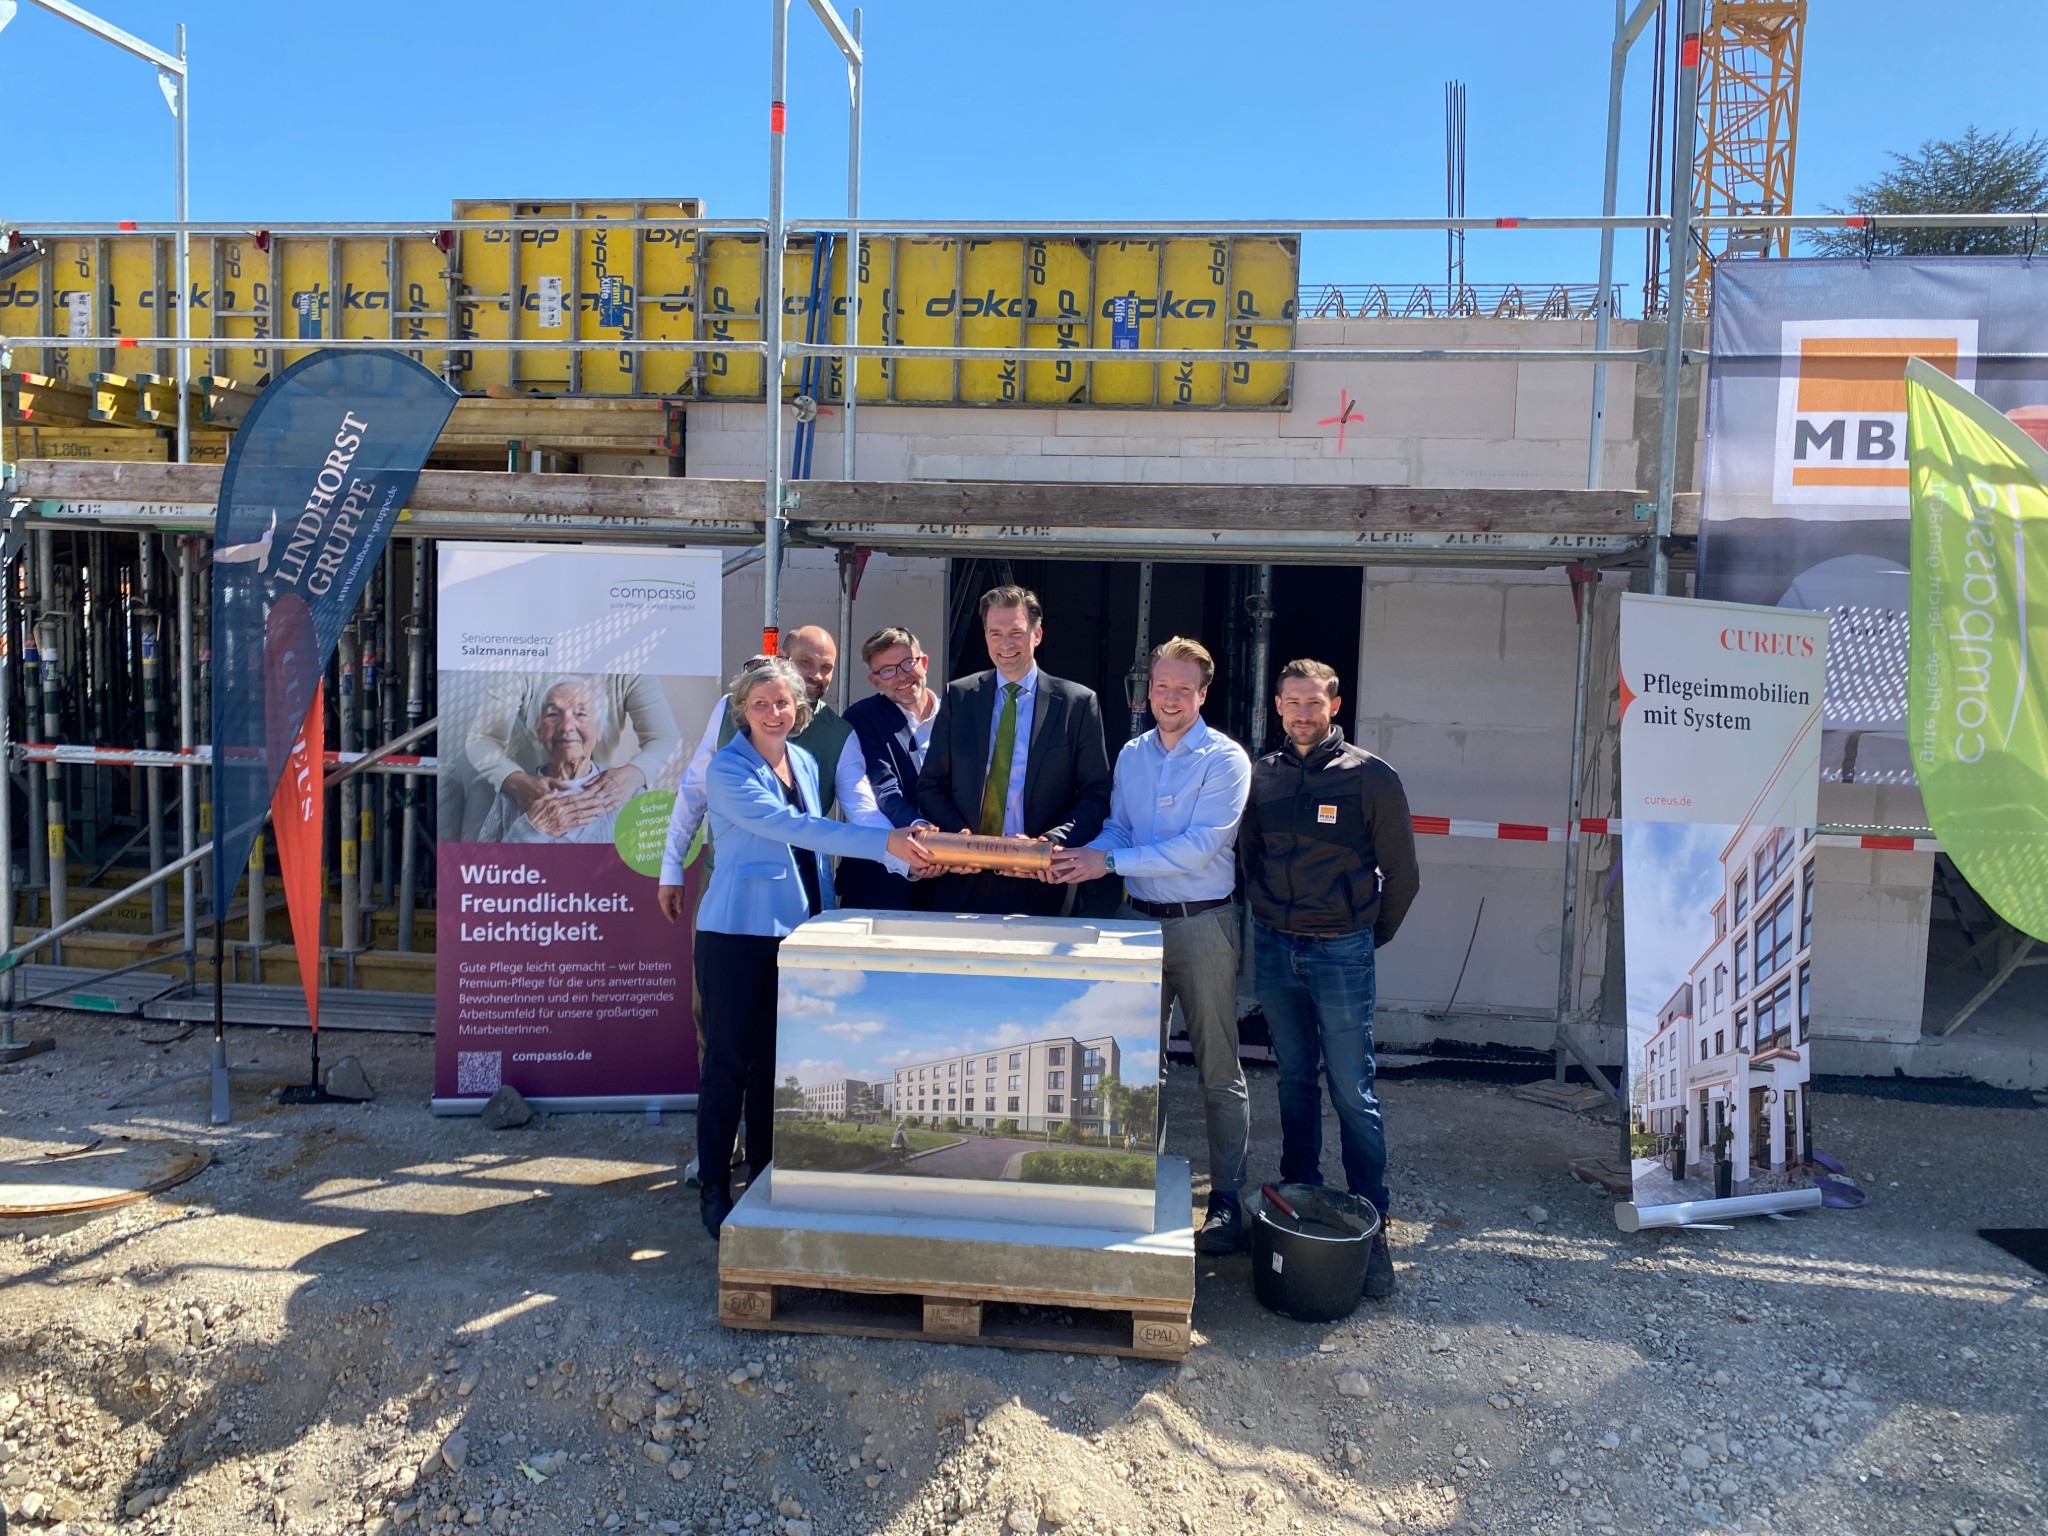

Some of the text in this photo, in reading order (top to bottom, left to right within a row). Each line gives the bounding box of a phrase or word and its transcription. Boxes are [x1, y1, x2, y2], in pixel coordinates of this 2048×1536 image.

[925, 289, 1038, 318] doka
[1102, 290, 1216, 319] doka
[1114, 298, 1125, 323] Xlife
[1127, 298, 1139, 329] Frami
[1794, 420, 1909, 460] MB
[274, 411, 368, 586] LINDHORST
[307, 478, 376, 596] GRUPPE
[610, 584, 696, 601] compassio
[461, 633, 554, 645] Seniorenresidenz
[1720, 628, 1814, 658] CUREUS
[461, 645, 548, 657] Salzmannareal
[1643, 673, 1810, 706] Pflegeimmobilien
[1644, 706, 1751, 732] mit System
[640, 803, 668, 814] Sicher
[1644, 795, 1692, 807] cureus.de
[638, 840, 662, 850] Haus
[966, 841, 1020, 853] CUREUS
[460, 864, 547, 885] Würde.
[460, 892, 635, 913] Freundlichkeit.
[460, 921, 604, 946] Leichtigkeit.
[459, 962, 487, 974] Gute
[490, 962, 523, 977] Pflege
[526, 961, 555, 973] leicht
[558, 961, 606, 976] gemacht
[618, 961, 635, 972] wir
[638, 960, 671, 971] bieten
[459, 976, 676, 992] Premium-Pflege für die uns anvertrauten
[459, 991, 674, 1005] BewohnerInnen und ein hervorragendes
[459, 1006, 659, 1020] Arbeitsumfeld für unsere großartigen
[459, 1023, 552, 1035] MitarbeiterInnen.
[512, 1049, 592, 1062] compassio.de
[1145, 1328, 1174, 1342] EPAL
